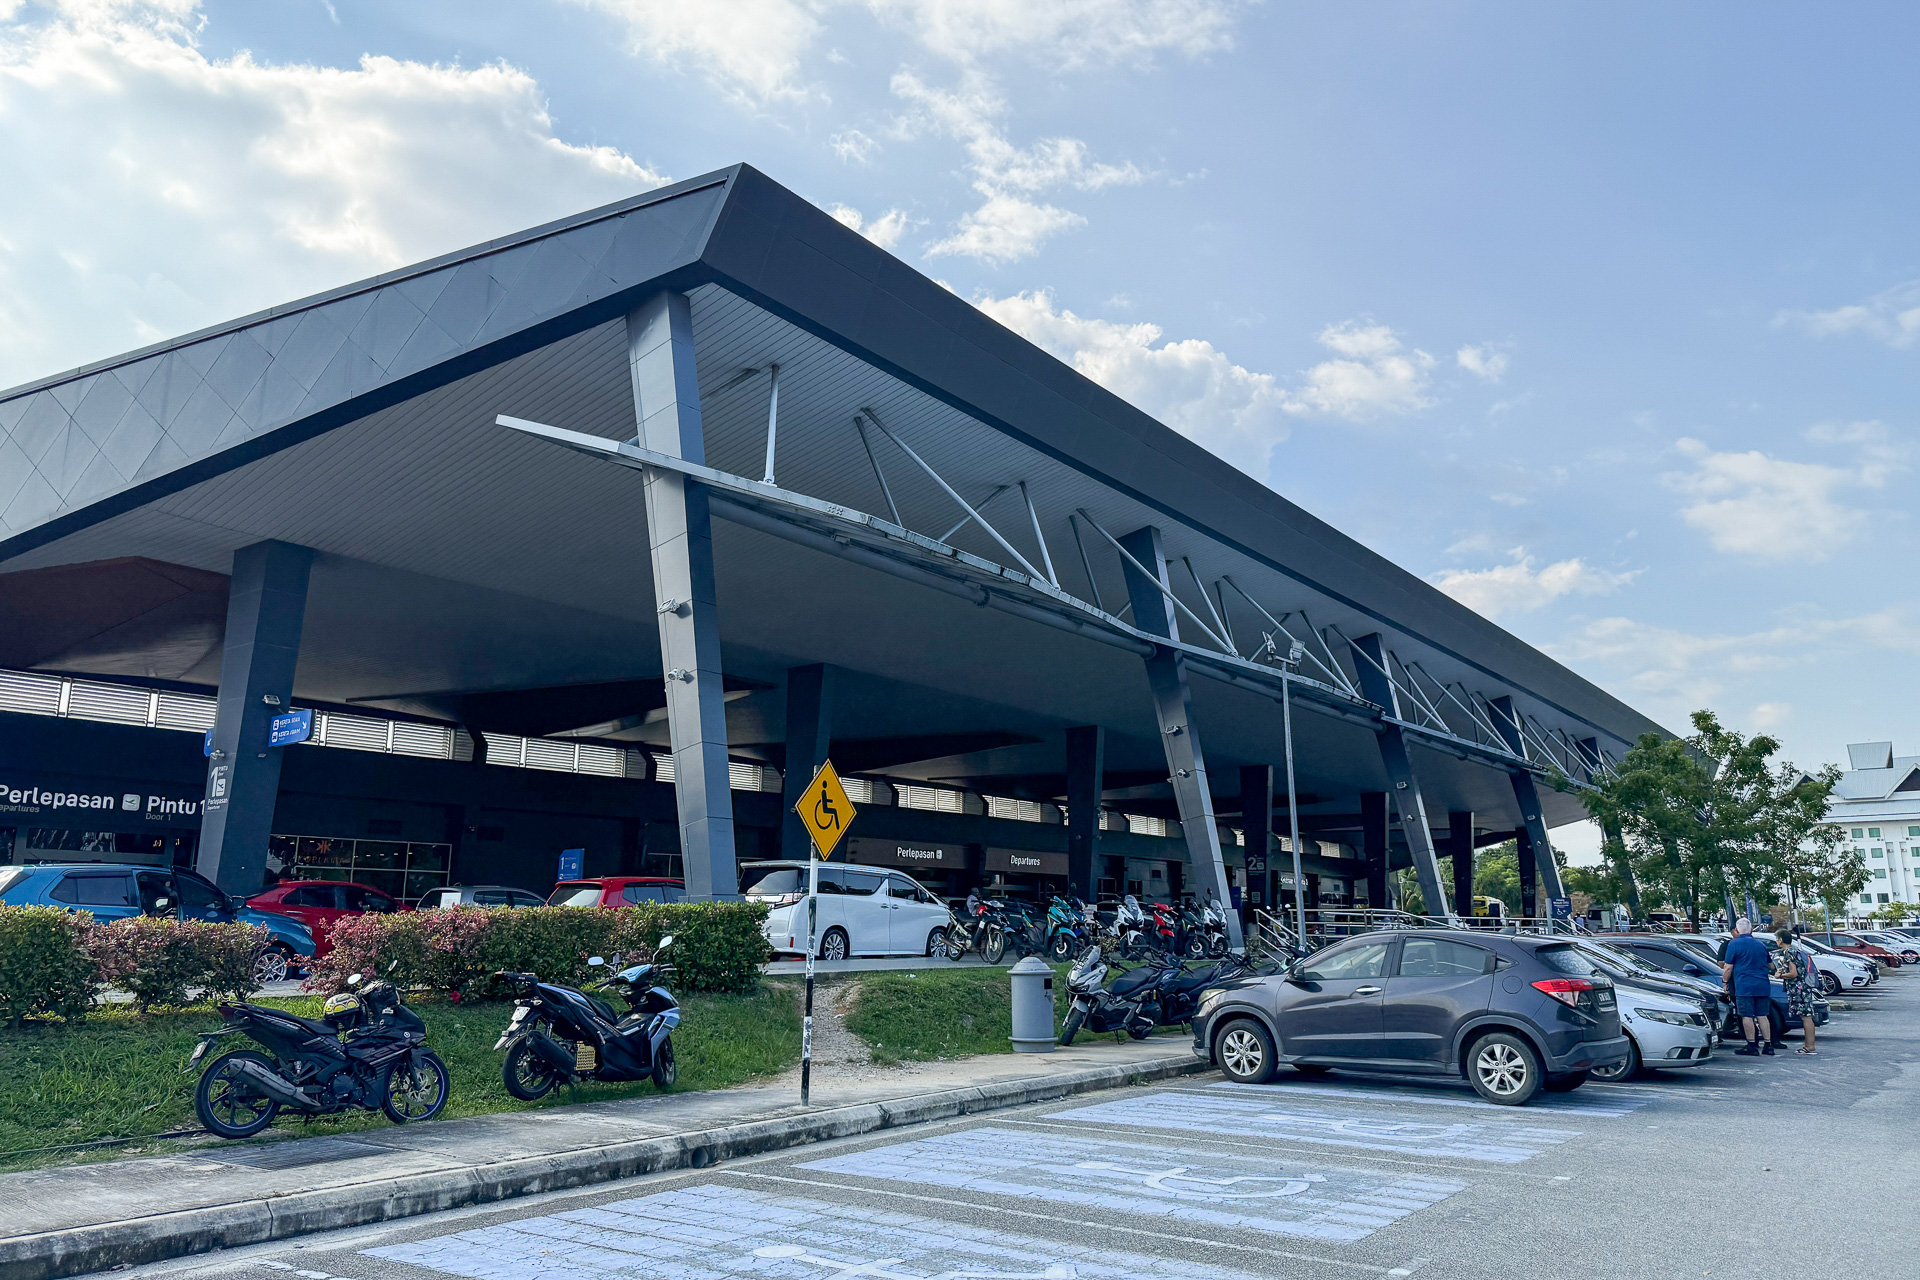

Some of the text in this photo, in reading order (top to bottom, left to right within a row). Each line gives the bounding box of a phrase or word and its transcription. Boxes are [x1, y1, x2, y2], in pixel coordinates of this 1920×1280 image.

[211, 767, 218, 797] 1
[0, 784, 115, 809] Perlepasan
[147, 795, 197, 815] Pintu
[0, 804, 40, 813] epartures
[145, 812, 164, 821] Door
[897, 846, 934, 860] Perlepasan
[560, 857, 565, 870] 1
[1010, 854, 1041, 867] Departures
[1248, 857, 1256, 870] 2
[1523, 885, 1529, 894] 3
